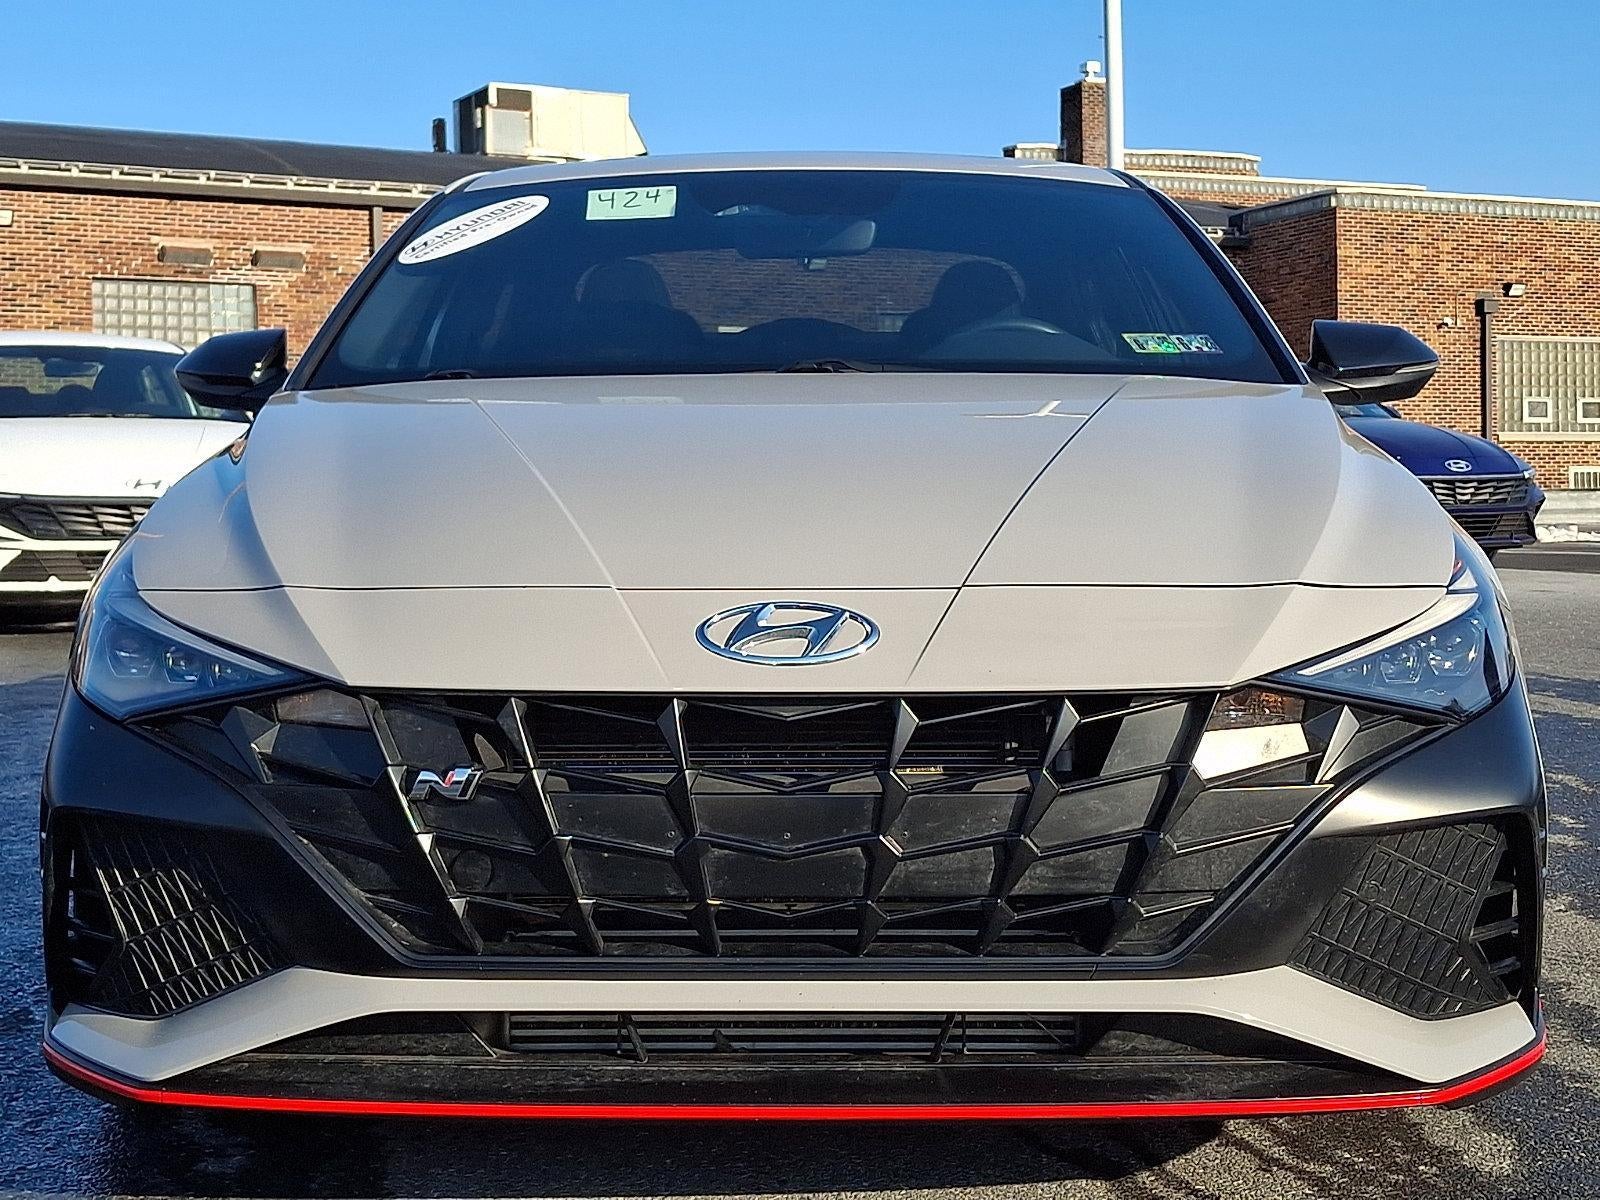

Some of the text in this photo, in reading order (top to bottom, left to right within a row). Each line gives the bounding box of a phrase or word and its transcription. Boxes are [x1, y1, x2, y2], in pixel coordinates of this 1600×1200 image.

[598, 188, 662, 210] 424
[414, 203, 539, 259] Certified Pre-Owned
[435, 200, 527, 240] HYUNDAI
